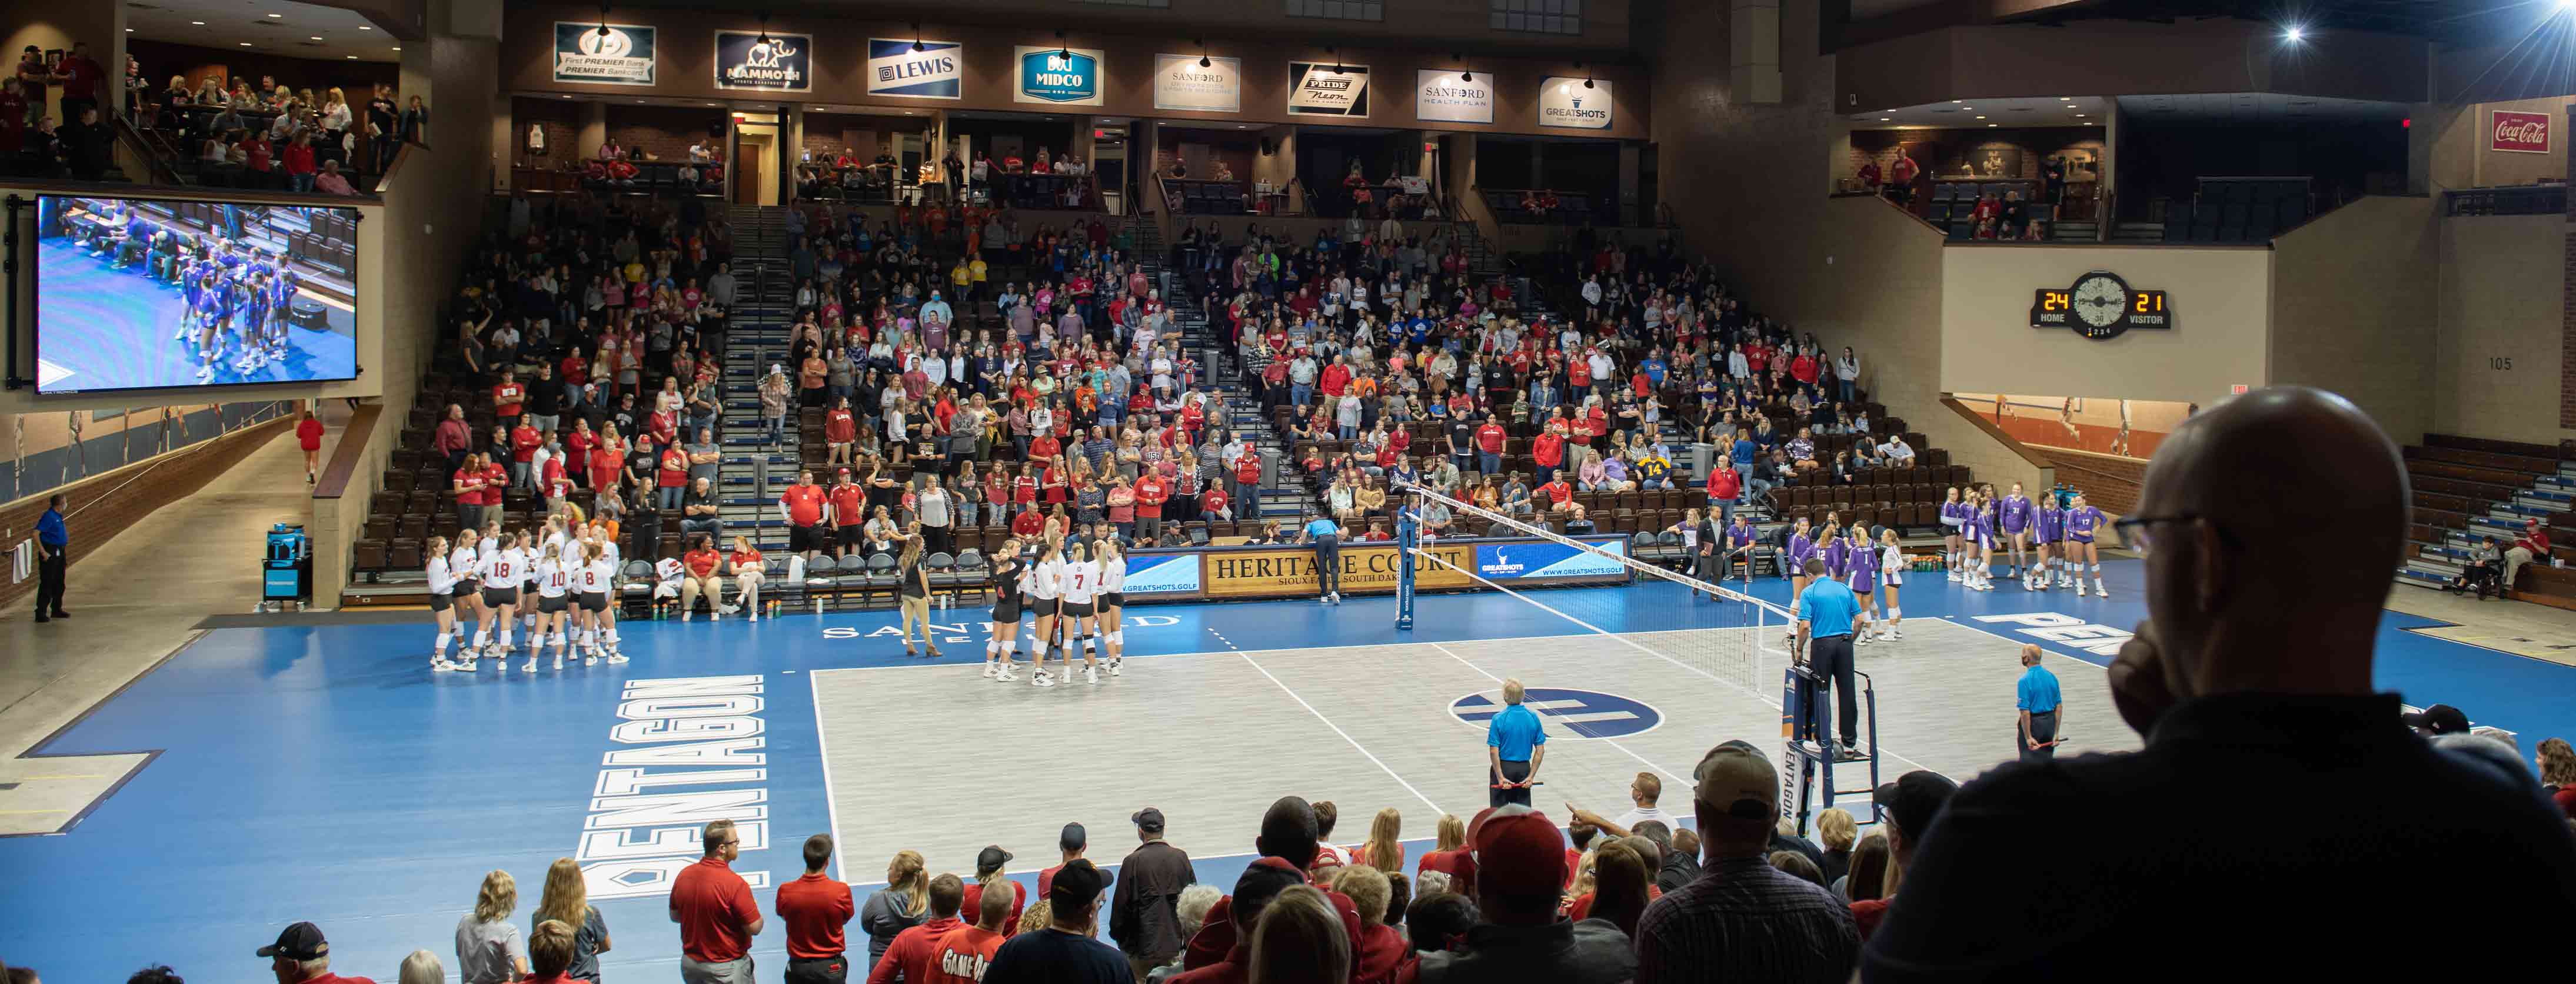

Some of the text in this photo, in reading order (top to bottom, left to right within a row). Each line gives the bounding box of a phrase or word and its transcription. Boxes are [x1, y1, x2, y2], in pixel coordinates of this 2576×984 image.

[565, 56, 583, 65] First
[585, 58, 624, 67] PREMIER
[896, 57, 954, 79] LEWIS
[726, 68, 800, 81] MAMMOTH
[1036, 73, 1083, 87] MIDCO
[1172, 72, 1223, 82] SANFORD
[1308, 91, 1349, 100] Neon
[1426, 87, 1485, 98] SANFORD
[1546, 108, 1606, 118] GREATSHOTS
[2495, 119, 2547, 144] Coca-Cola
[2044, 292, 2069, 311] 24
[2136, 293, 2161, 313] 21
[2041, 314, 2065, 323] HOME
[2130, 315, 2164, 324] VISITOR
[2490, 357, 2512, 371] 105
[1648, 464, 1662, 476] 14
[1817, 549, 1826, 561] 12
[494, 562, 510, 578] 18
[1216, 555, 1357, 579] HERITAE
[1543, 567, 1622, 576] WWW.GREATSHOTS.GOLF
[551, 571, 565, 587] 10
[585, 571, 594, 585] 8
[1075, 574, 1083, 589] 7
[1279, 576, 1308, 585] SIOUX
[1343, 574, 1375, 583] SOUTH
[1379, 573, 1417, 582] DAKA
[1783, 748, 1795, 819] ENTAGON
[943, 948, 989, 984] GAME DA
